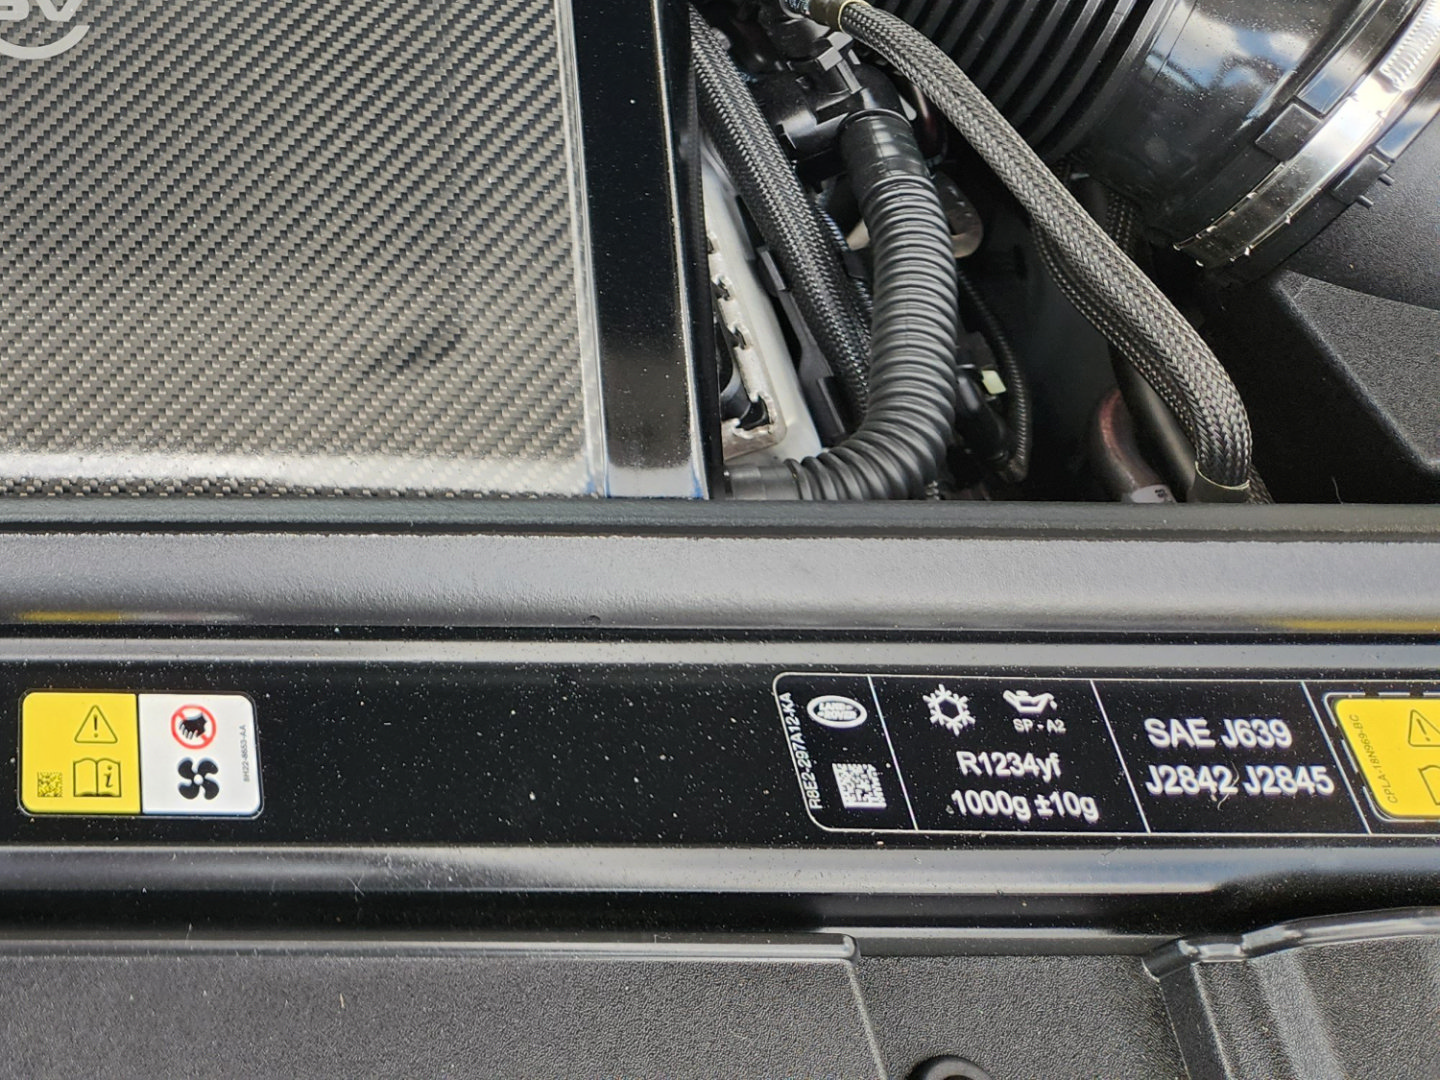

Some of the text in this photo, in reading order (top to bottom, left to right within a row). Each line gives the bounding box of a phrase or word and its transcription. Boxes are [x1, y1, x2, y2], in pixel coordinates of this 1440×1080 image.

[1013, 719, 1034, 733] SP
[1046, 719, 1066, 734] A2
[1144, 718, 1293, 748] SAE J639
[955, 750, 1061, 783] R1234yf
[1145, 765, 1335, 796] J2842 J2845
[951, 789, 1100, 823] 1000g ±10g
